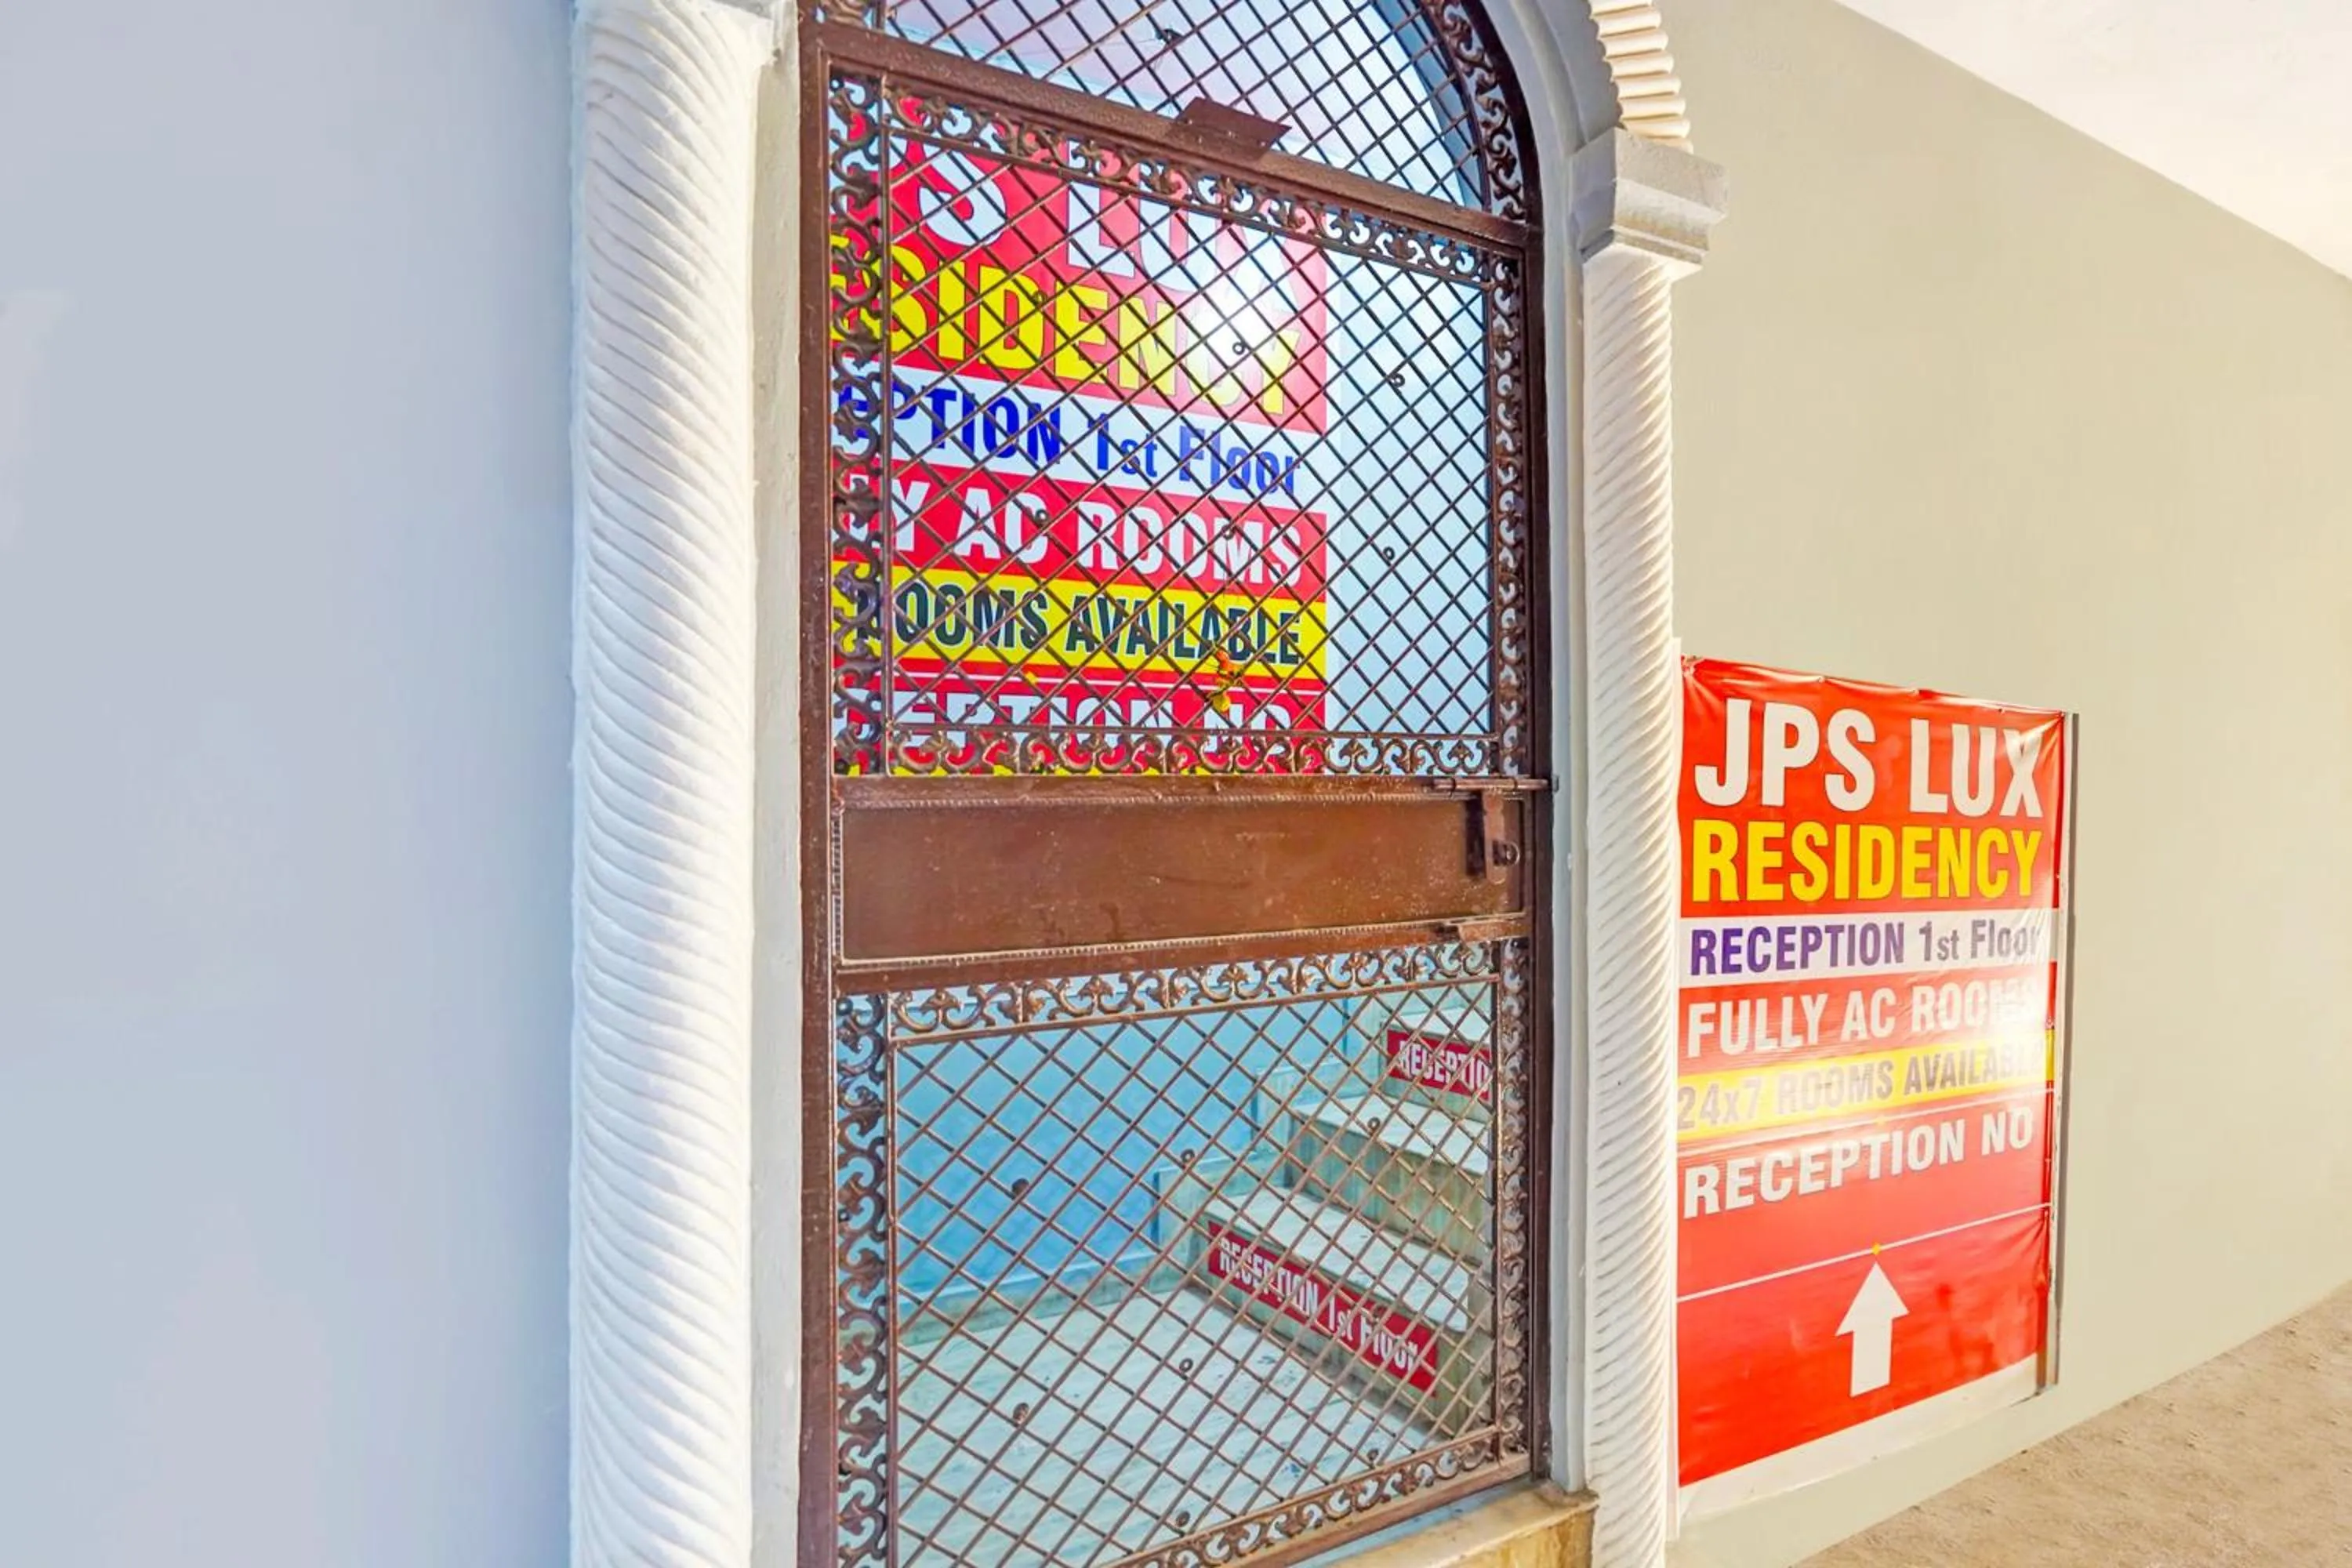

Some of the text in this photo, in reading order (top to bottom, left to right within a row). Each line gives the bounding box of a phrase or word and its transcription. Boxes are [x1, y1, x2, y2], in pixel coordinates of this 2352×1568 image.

[1087, 413, 1158, 477] 1st
[1179, 426, 1301, 495] Floor
[954, 486, 1048, 564] AC
[1078, 500, 1301, 586] ROOMS
[1065, 593, 1301, 666] AVAILABLE
[1694, 698, 2045, 818] JPS LUX
[1692, 818, 2043, 903] RESIDENCY
[1690, 919, 2040, 975] RECEPTION 1st Floor
[1686, 978, 2037, 1058] FULLY AC ROO
[1678, 1039, 2045, 1131] 24x7 ROOMS AVAILAB
[1684, 1105, 2035, 1219] RECEPTION NO
